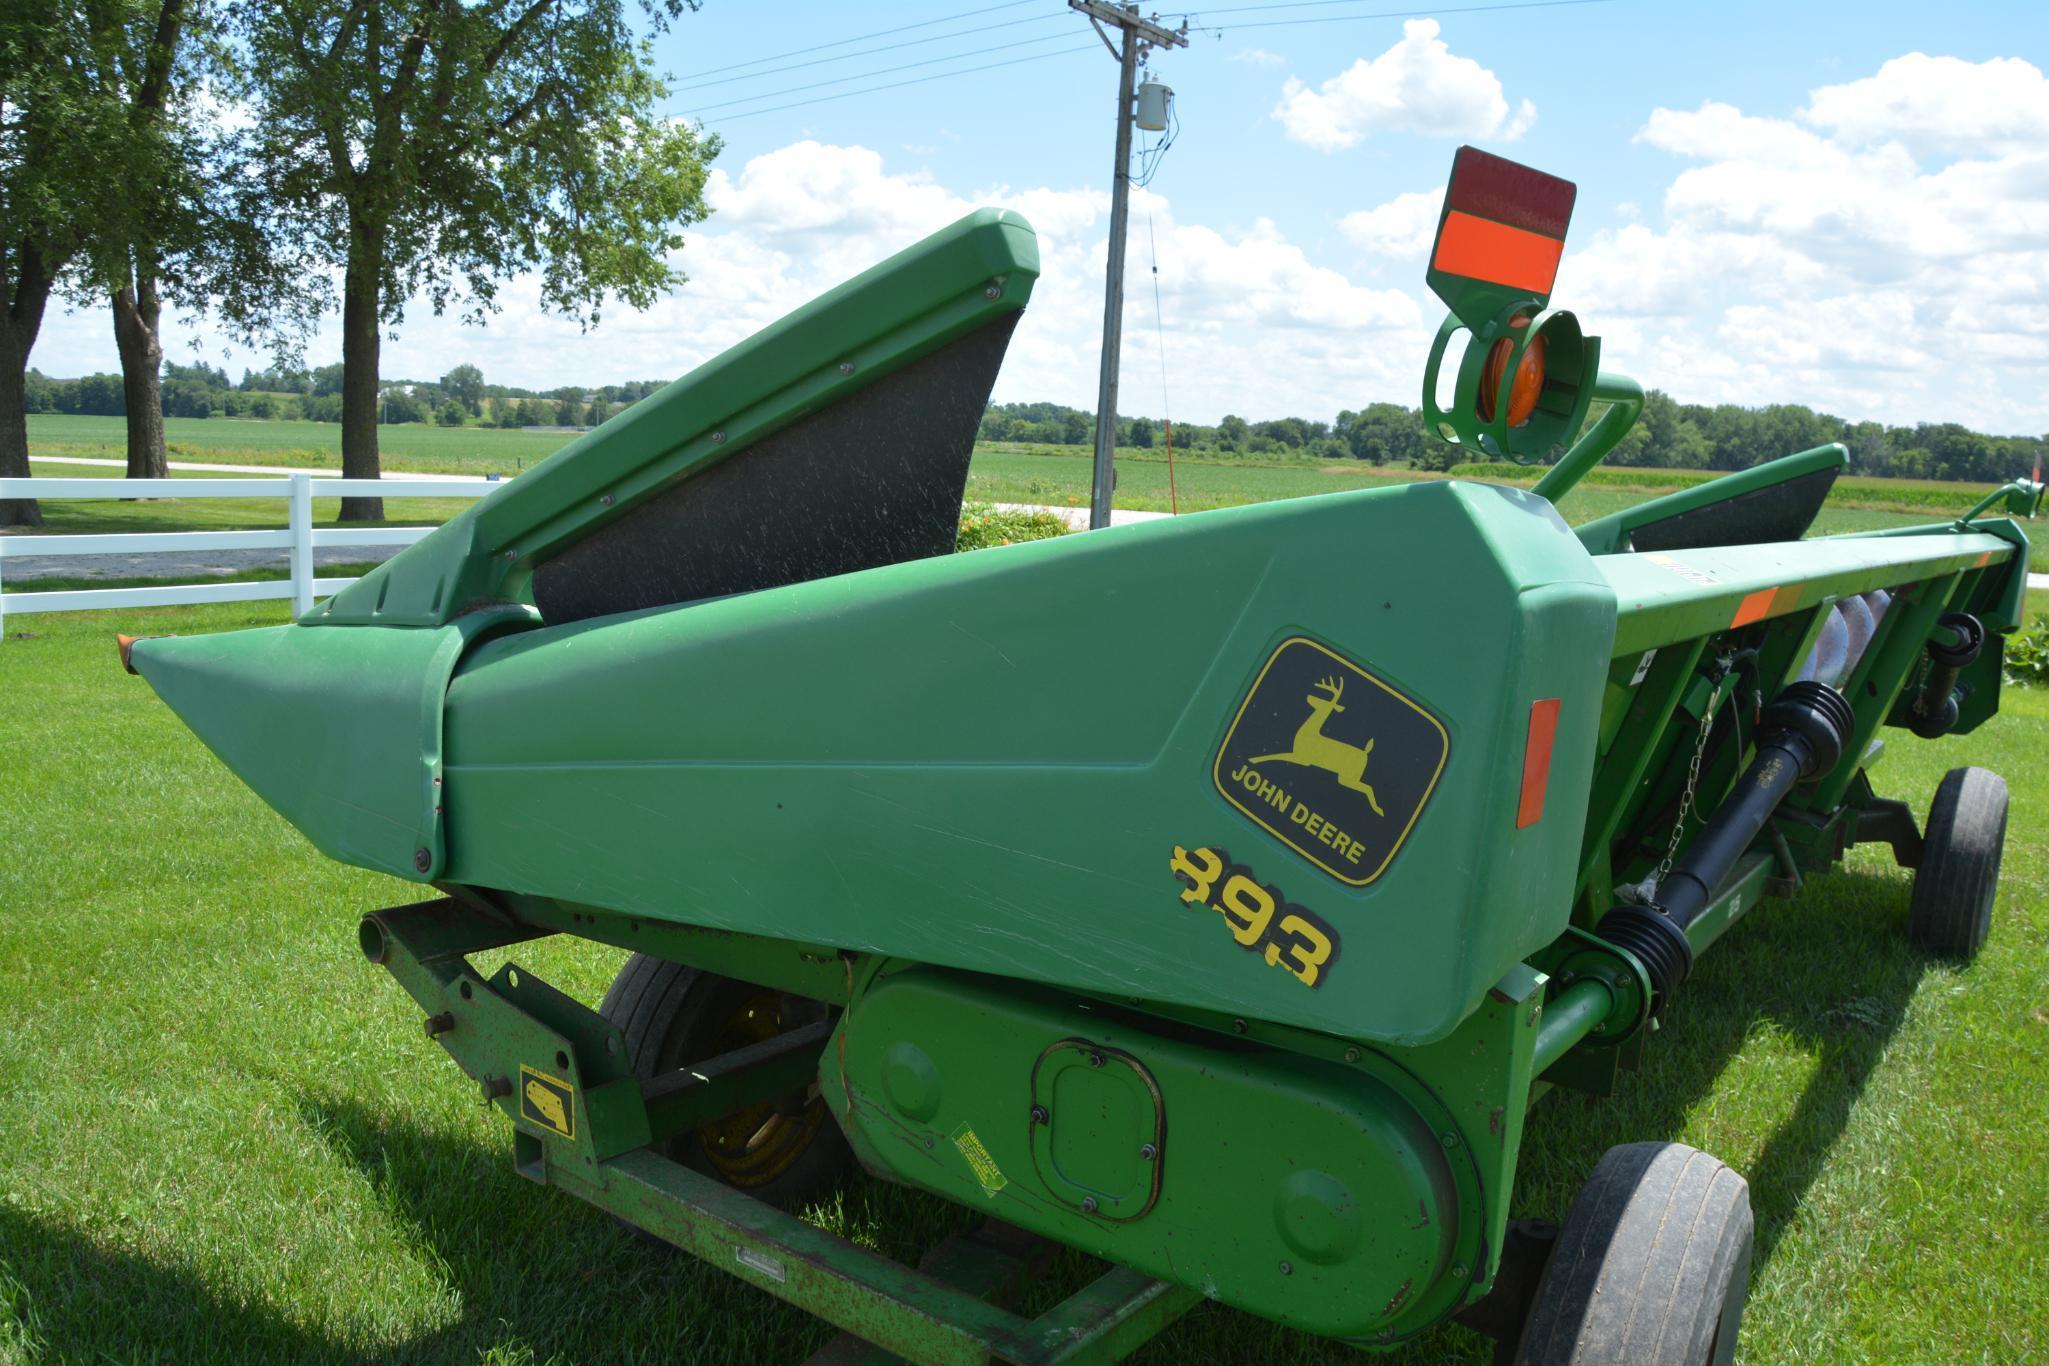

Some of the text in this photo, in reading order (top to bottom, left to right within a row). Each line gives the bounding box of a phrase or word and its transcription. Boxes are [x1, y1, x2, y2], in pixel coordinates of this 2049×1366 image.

[1231, 764, 1366, 865] JOHN DEERE
[1170, 845, 1332, 987] 893
[967, 1130, 1001, 1176] IMPORTANT
